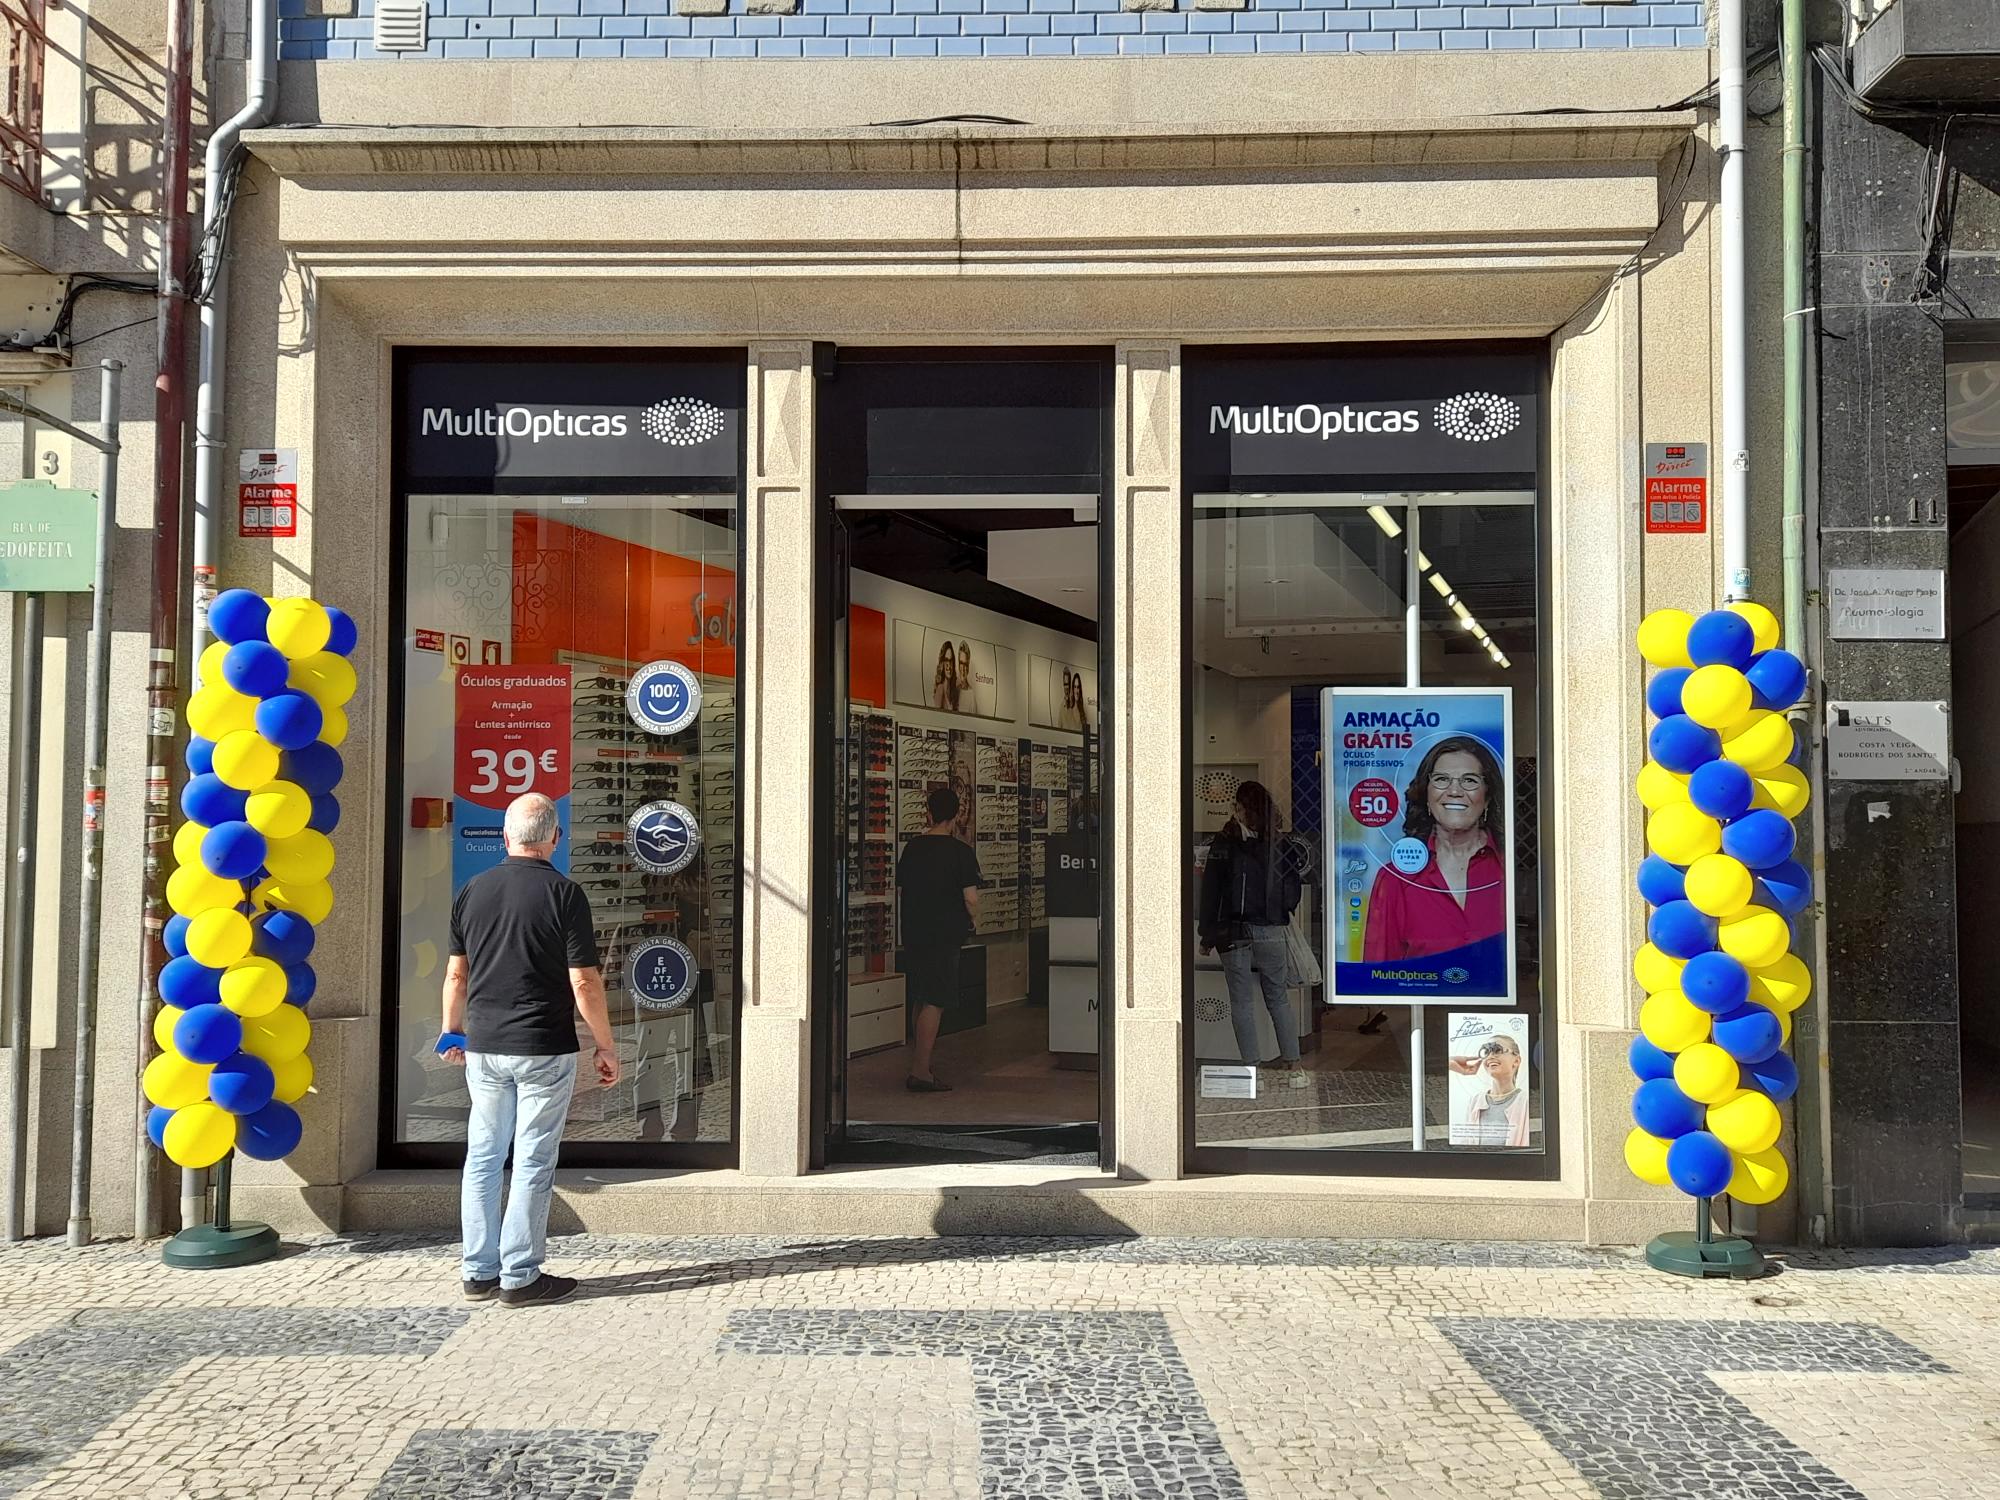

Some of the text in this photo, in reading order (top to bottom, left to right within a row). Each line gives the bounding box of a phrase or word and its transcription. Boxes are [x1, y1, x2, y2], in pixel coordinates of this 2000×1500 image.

[42, 450, 59, 475] 3
[243, 486, 292, 498] Alarme
[1650, 481, 1701, 493] Alarme
[1908, 497, 1938, 523] 11
[38, 522, 51, 533] DE
[461, 673, 567, 690] Óculos graduados
[669, 665, 698, 696] REEMBOLSO
[649, 684, 680, 698] 100%
[491, 701, 533, 711] Armação
[475, 720, 551, 729] Lentes antirrisco
[637, 716, 659, 732] NOSSA
[660, 711, 695, 732] PROMESSA
[1343, 708, 1441, 733] ARMAÇÃO
[1343, 730, 1413, 749] GRÁTIS
[1343, 751, 1375, 759] ÓCULOS
[1343, 760, 1405, 768] PROGRESSIVOS
[651, 803, 683, 816] VITALÍCIA
[682, 813, 697, 846] GRATUITA
[465, 842, 497, 852] Óculos
[633, 857, 656, 873] NOSSA
[656, 852, 693, 874] PROMESSA
[629, 939, 691, 962] CONSULTA GRATUITA
[657, 956, 665, 966] E
[654, 966, 667, 975] DF
[633, 992, 655, 1009] NOSSA
[656, 988, 692, 1009] PROMESSA
